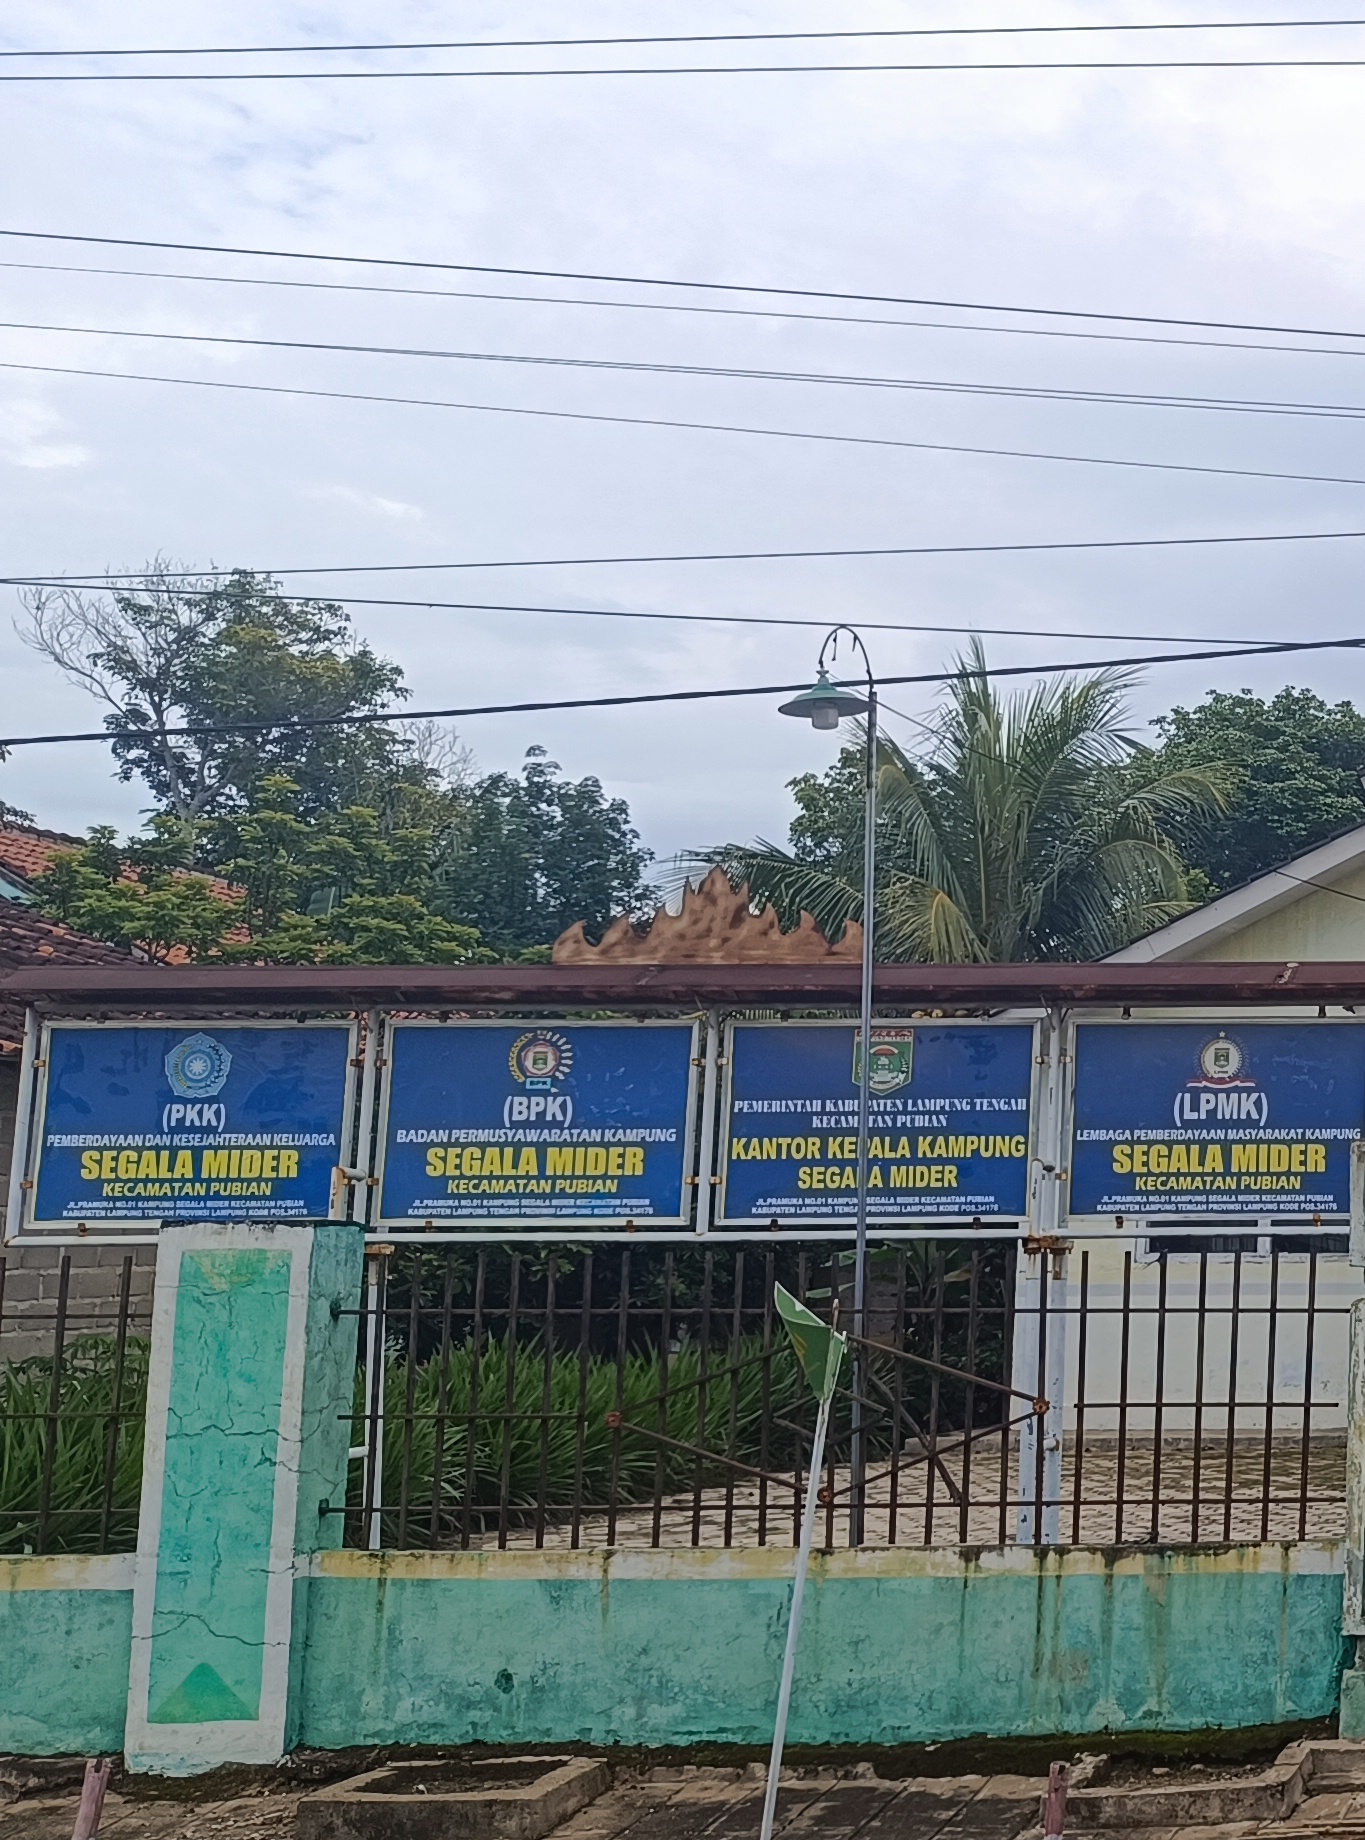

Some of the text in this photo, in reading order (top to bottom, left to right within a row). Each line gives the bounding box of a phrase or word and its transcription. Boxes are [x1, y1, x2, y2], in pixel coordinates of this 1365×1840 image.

[504, 1096, 572, 1127] (BPK)
[734, 1100, 821, 1112] PEMERINTAH
[908, 1099, 970, 1111] LAMPUNG
[974, 1098, 1026, 1110] TENGAH
[1174, 1092, 1268, 1126] (LPMK)
[162, 1104, 226, 1132] (PKK)
[812, 1116, 894, 1128] KECAMTAN
[47, 1134, 336, 1147] PEMBERDAYAAN DAN KESEJAHTERAAN KELUARGA
[396, 1129, 676, 1142] BADAN PERMUSYAWARATAN KAMPUNG
[1076, 1128, 1360, 1140] LEMBAGA PEMBERDAYAAN MASYARAKAT KAMPUNG
[732, 1138, 820, 1160] KANTOR
[918, 1136, 1026, 1158] KAMPUNG
[81, 1150, 298, 1179] SEGALA MIDER
[426, 1147, 644, 1176] SEGALA MIDER
[1112, 1144, 1326, 1173] SEGALA MIDER
[798, 1166, 958, 1188] SEGAA MIDER
[1136, 1176, 1300, 1190] KECAMATAN PUBIAN
[102, 1182, 272, 1196] KECAMATAN PUBIAN
[448, 1180, 618, 1194] KECAMATAN PUBIAN
